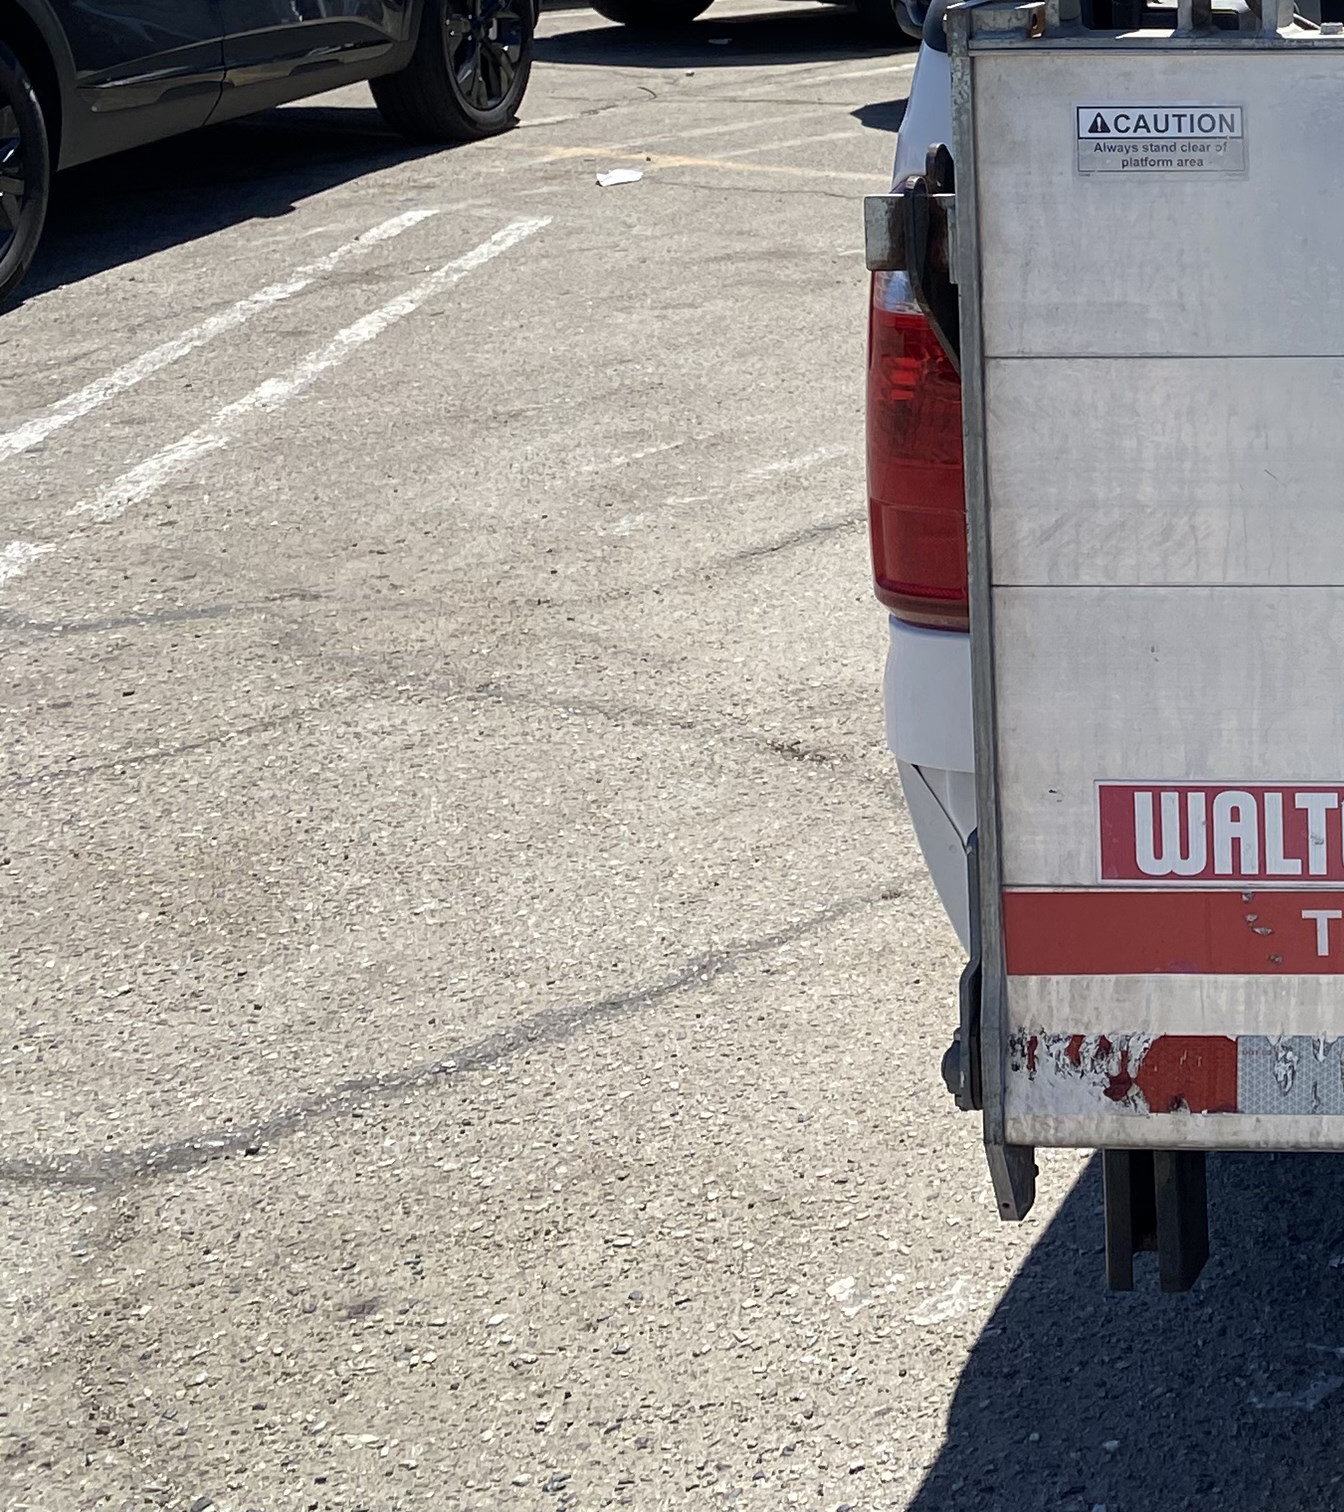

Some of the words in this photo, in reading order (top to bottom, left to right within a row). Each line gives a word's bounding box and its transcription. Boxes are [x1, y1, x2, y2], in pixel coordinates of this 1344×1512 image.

[1113, 113, 1236, 134] CAUTION
[1093, 142, 1139, 155] Always
[1142, 142, 1177, 153] stand
[1180, 142, 1211, 153] clear
[1215, 142, 1228, 153] of
[1121, 157, 1173, 169] platform
[1176, 158, 1204, 168] area
